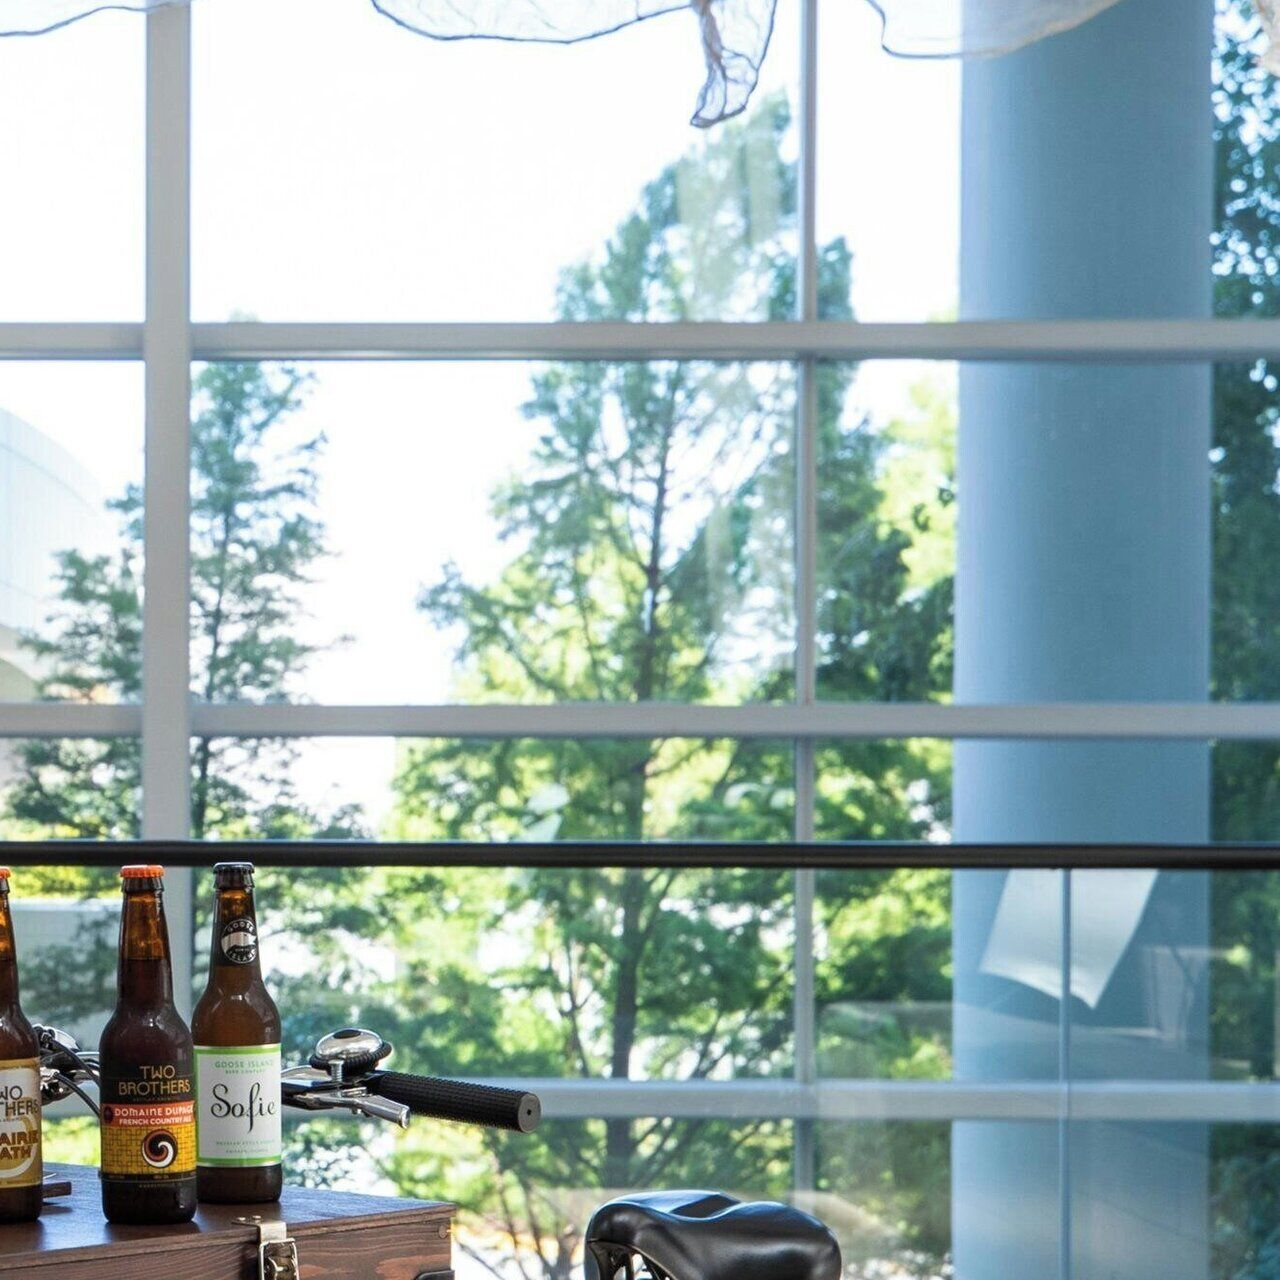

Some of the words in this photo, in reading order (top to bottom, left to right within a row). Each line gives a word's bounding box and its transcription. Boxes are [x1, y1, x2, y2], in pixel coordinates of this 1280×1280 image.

[140, 1065, 176, 1079] TWO
[119, 1079, 191, 1096] BROTHERS
[211, 1081, 276, 1135] Sofie
[120, 1118, 148, 1126] FRENCH
[150, 1116, 181, 1125] COUNTRY
